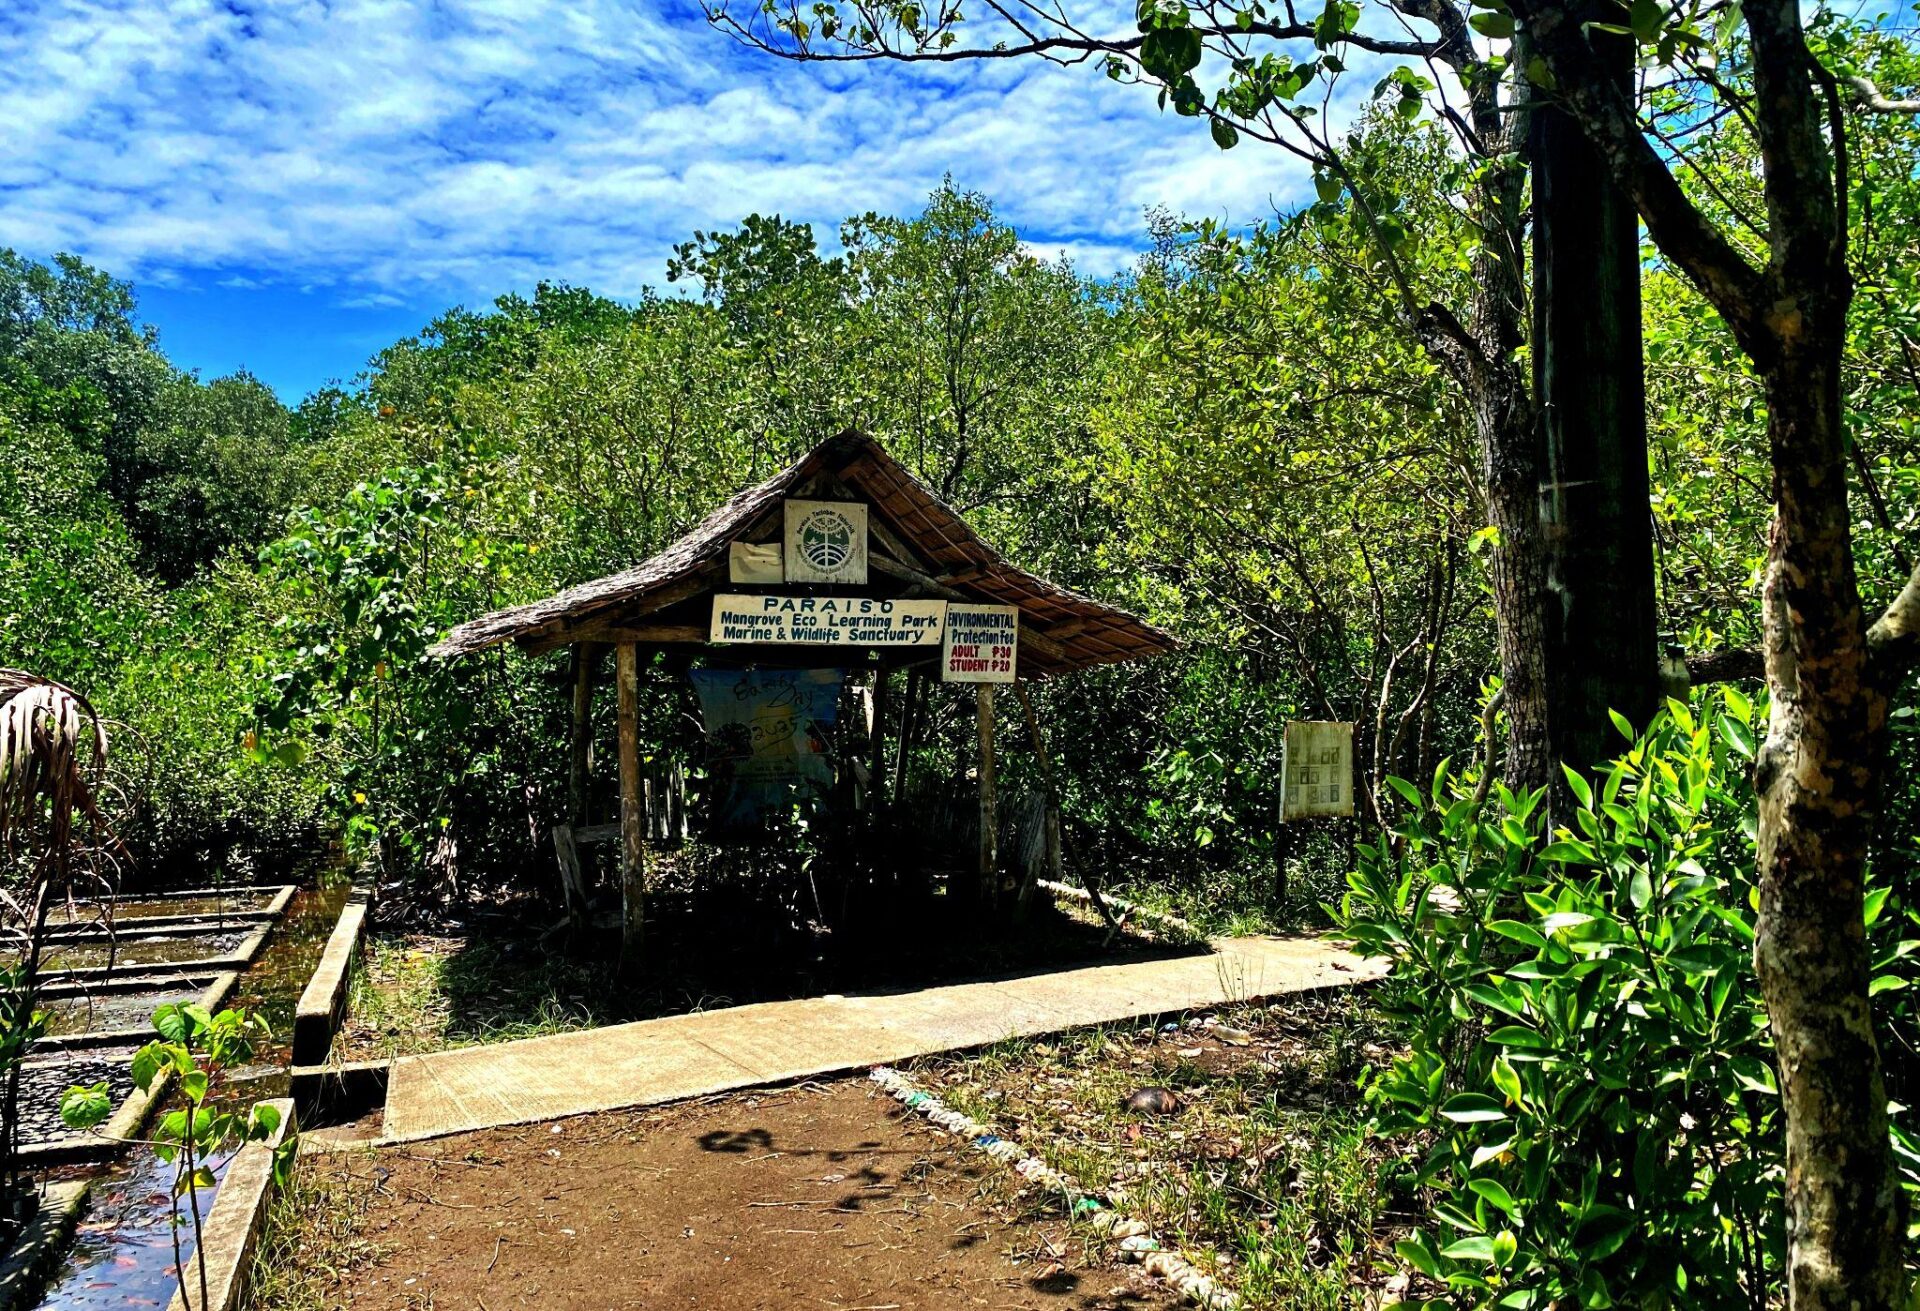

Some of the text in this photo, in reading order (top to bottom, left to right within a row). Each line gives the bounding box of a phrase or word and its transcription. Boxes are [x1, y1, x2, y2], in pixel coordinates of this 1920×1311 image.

[764, 598, 893, 613] PARAISO
[721, 611, 938, 629] Mangrove Eco Learning Park
[948, 612, 1015, 628] ENVIRONMENTAL
[724, 626, 924, 643] Marine & Wildlife Sanctuary
[952, 629, 998, 644] Protection
[951, 645, 980, 658] ADULT
[949, 659, 989, 672] STUDENT
